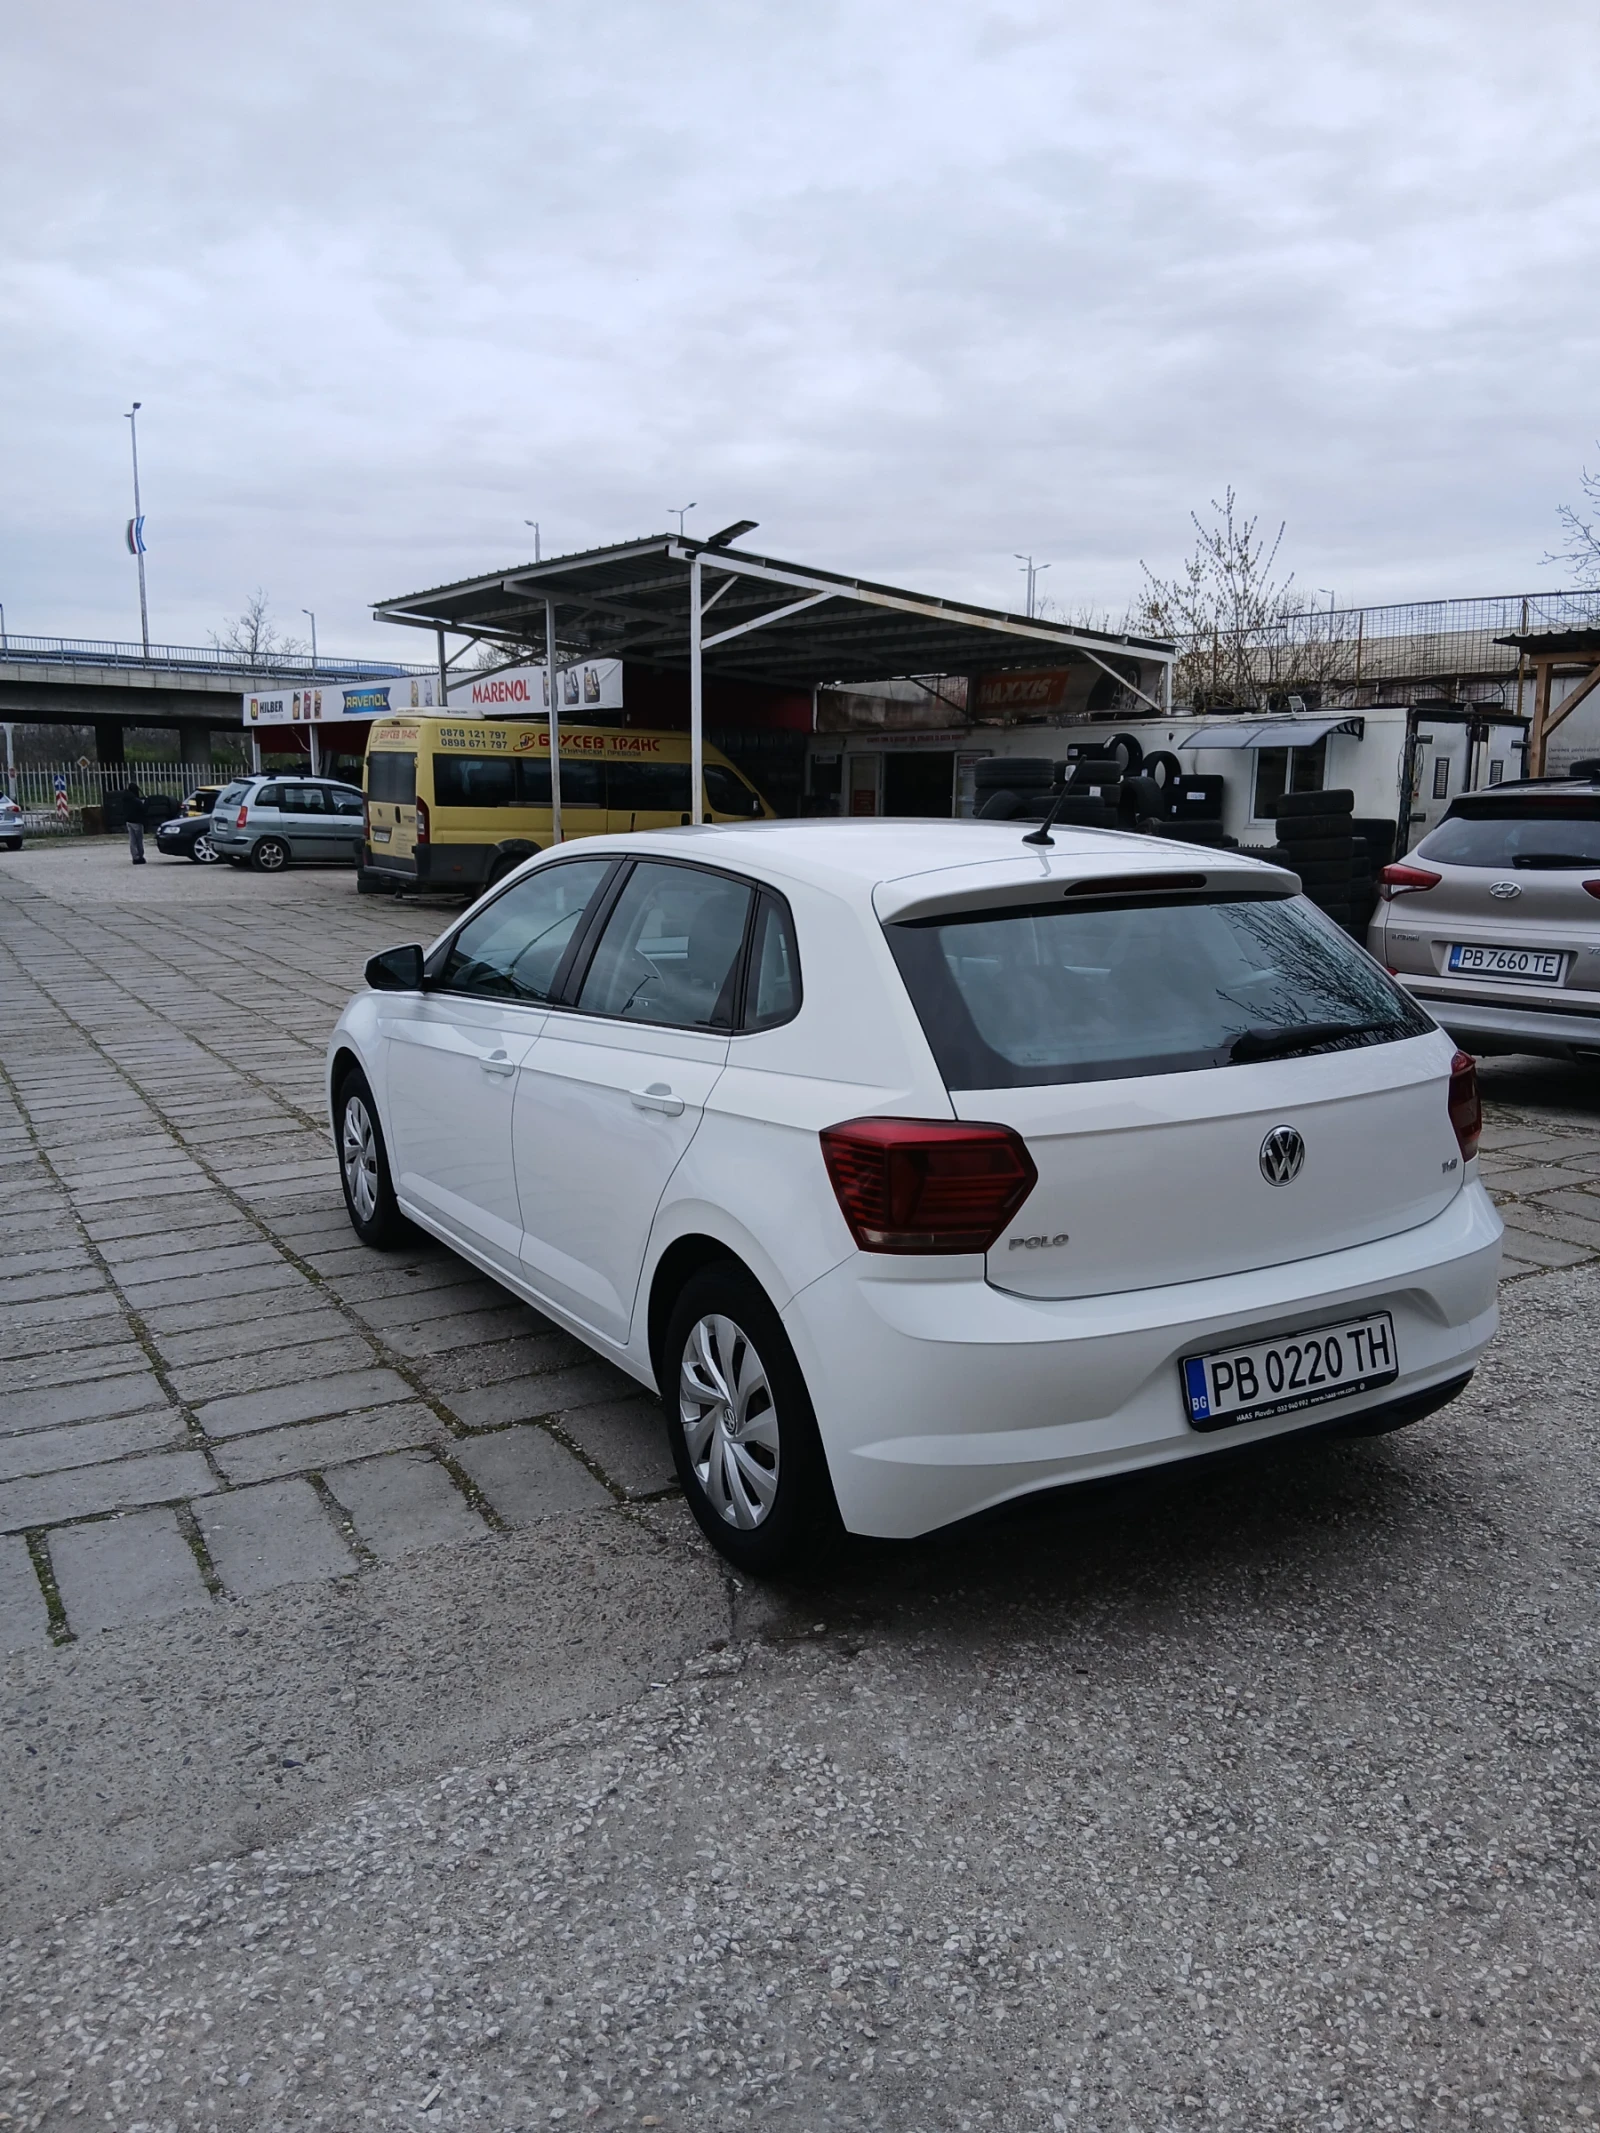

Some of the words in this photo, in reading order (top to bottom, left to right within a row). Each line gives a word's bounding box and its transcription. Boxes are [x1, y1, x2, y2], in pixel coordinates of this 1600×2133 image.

[346, 693, 387, 709] RAVENOL
[472, 680, 531, 704] MARENOL
[977, 679, 1052, 704] MAXXIS
[440, 728, 465, 738] 0878
[468, 729, 485, 739] 121
[489, 730, 507, 740] 797
[538, 733, 605, 749] БУСЕВ
[610, 737, 661, 751] ТРАНС
[441, 738, 466, 748] 0898
[469, 739, 486, 749] 671
[489, 740, 508, 750] 797
[1461, 950, 1484, 967] PB
[1486, 950, 1529, 971] 7660
[1533, 955, 1554, 974] TE
[1008, 1232, 1069, 1251] POLO
[1210, 1356, 1260, 1408] PB
[1265, 1336, 1343, 1394] 0220
[1346, 1323, 1391, 1372] TH
[1192, 1395, 1208, 1412] BG
[1236, 1412, 1253, 1422] HAAS
[1254, 1408, 1275, 1419] Plovdiv
[1276, 1403, 1288, 1413] 032
